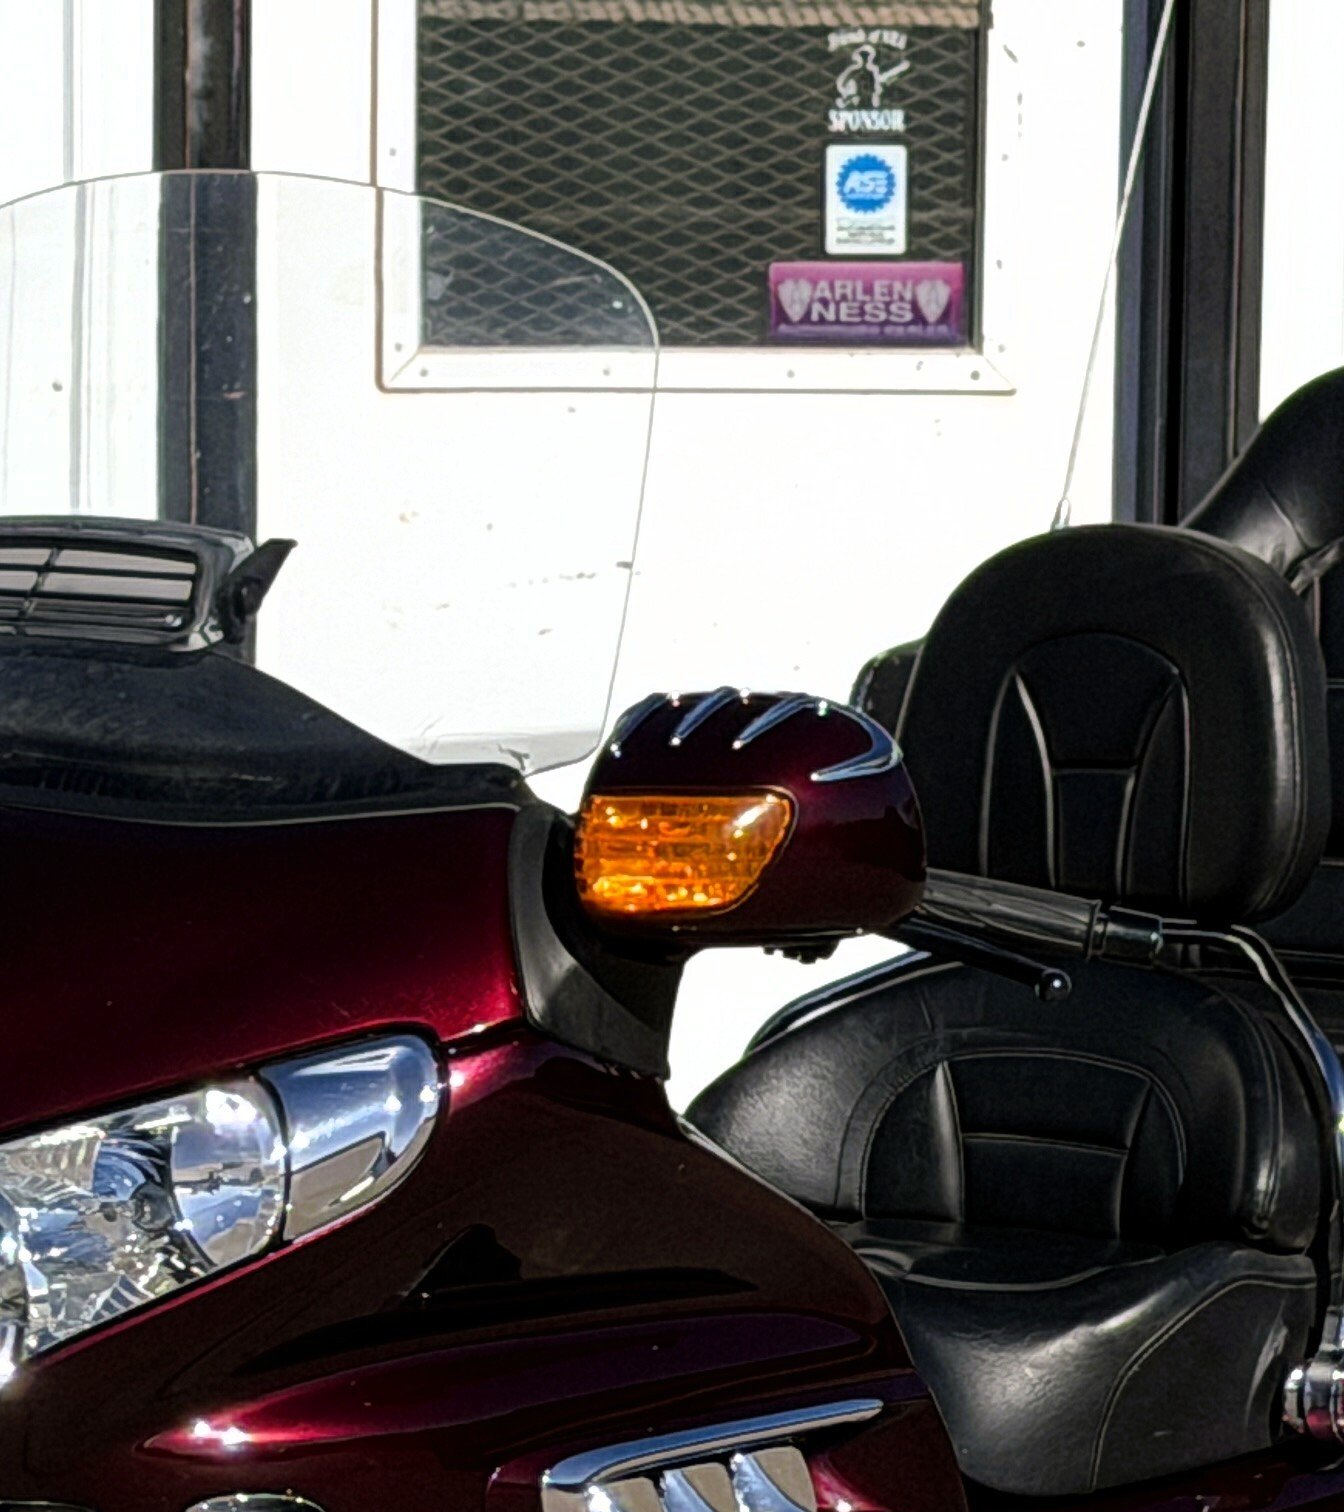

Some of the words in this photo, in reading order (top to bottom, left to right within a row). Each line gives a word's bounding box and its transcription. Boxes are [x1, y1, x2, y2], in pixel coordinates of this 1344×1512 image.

[843, 171, 887, 194] ASE
[813, 279, 913, 302] ARLEN
[810, 302, 914, 323] NESS
